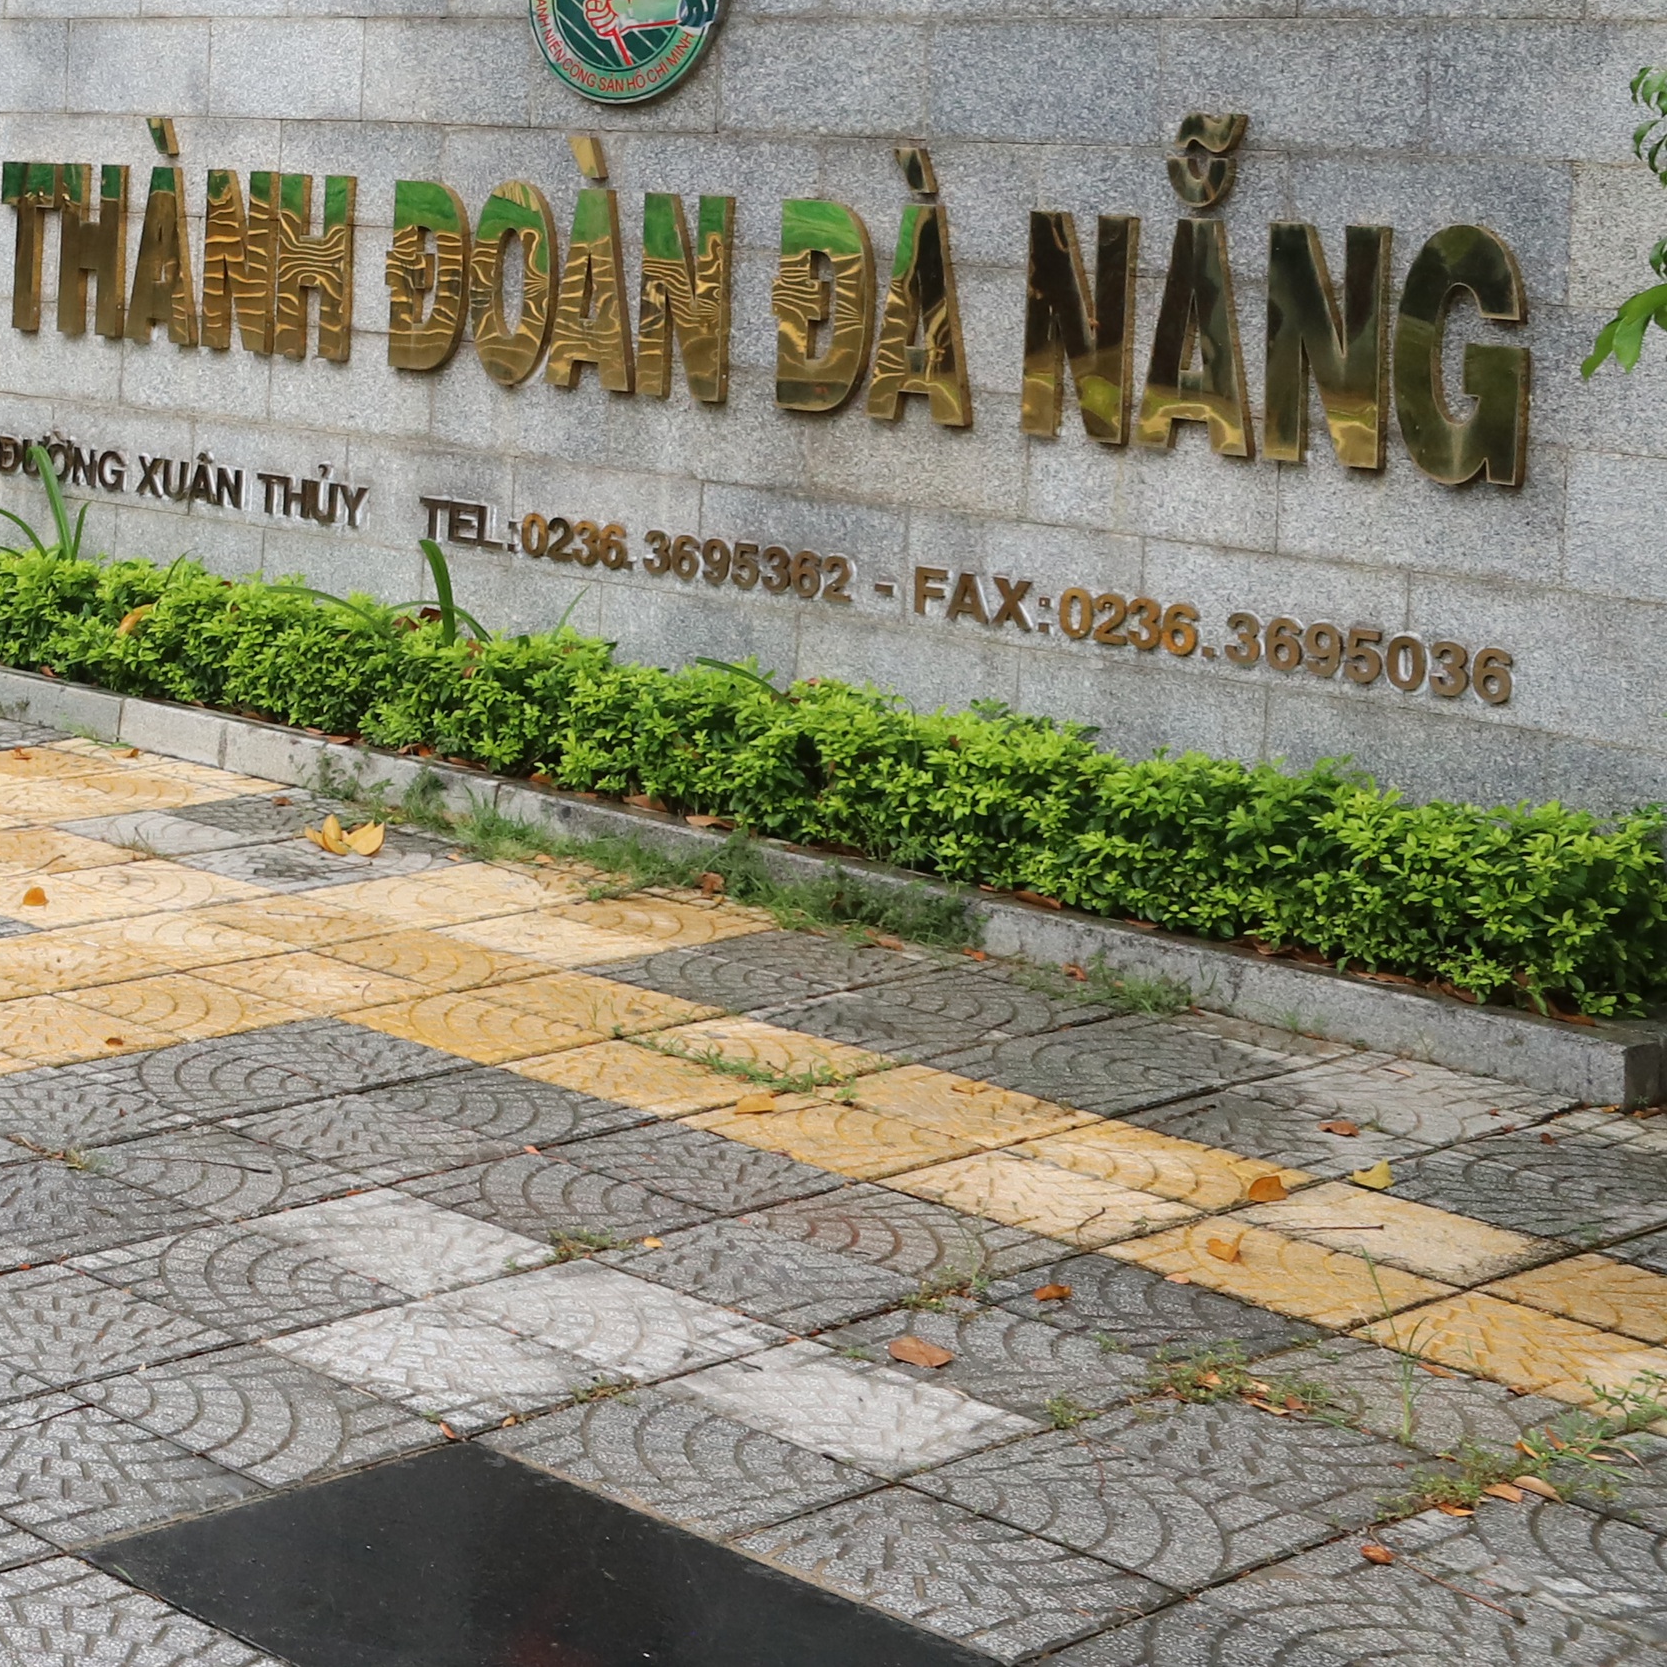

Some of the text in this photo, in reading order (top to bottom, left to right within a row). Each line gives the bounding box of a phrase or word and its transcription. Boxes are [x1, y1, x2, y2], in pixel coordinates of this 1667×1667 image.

[543, 26, 564, 65] NIÊN
[562, 55, 597, 89] CỘNG
[597, 73, 625, 94] SẢN
[626, 69, 647, 90] HỒ
[649, 62, 670, 84] CHÍ
[667, 32, 695, 66] MINH
[1, 112, 1531, 488] THÀNH ĐOÀN ĐÀ NẴNG
[136, 450, 245, 511] XUÂN
[257, 461, 371, 528] THỦY
